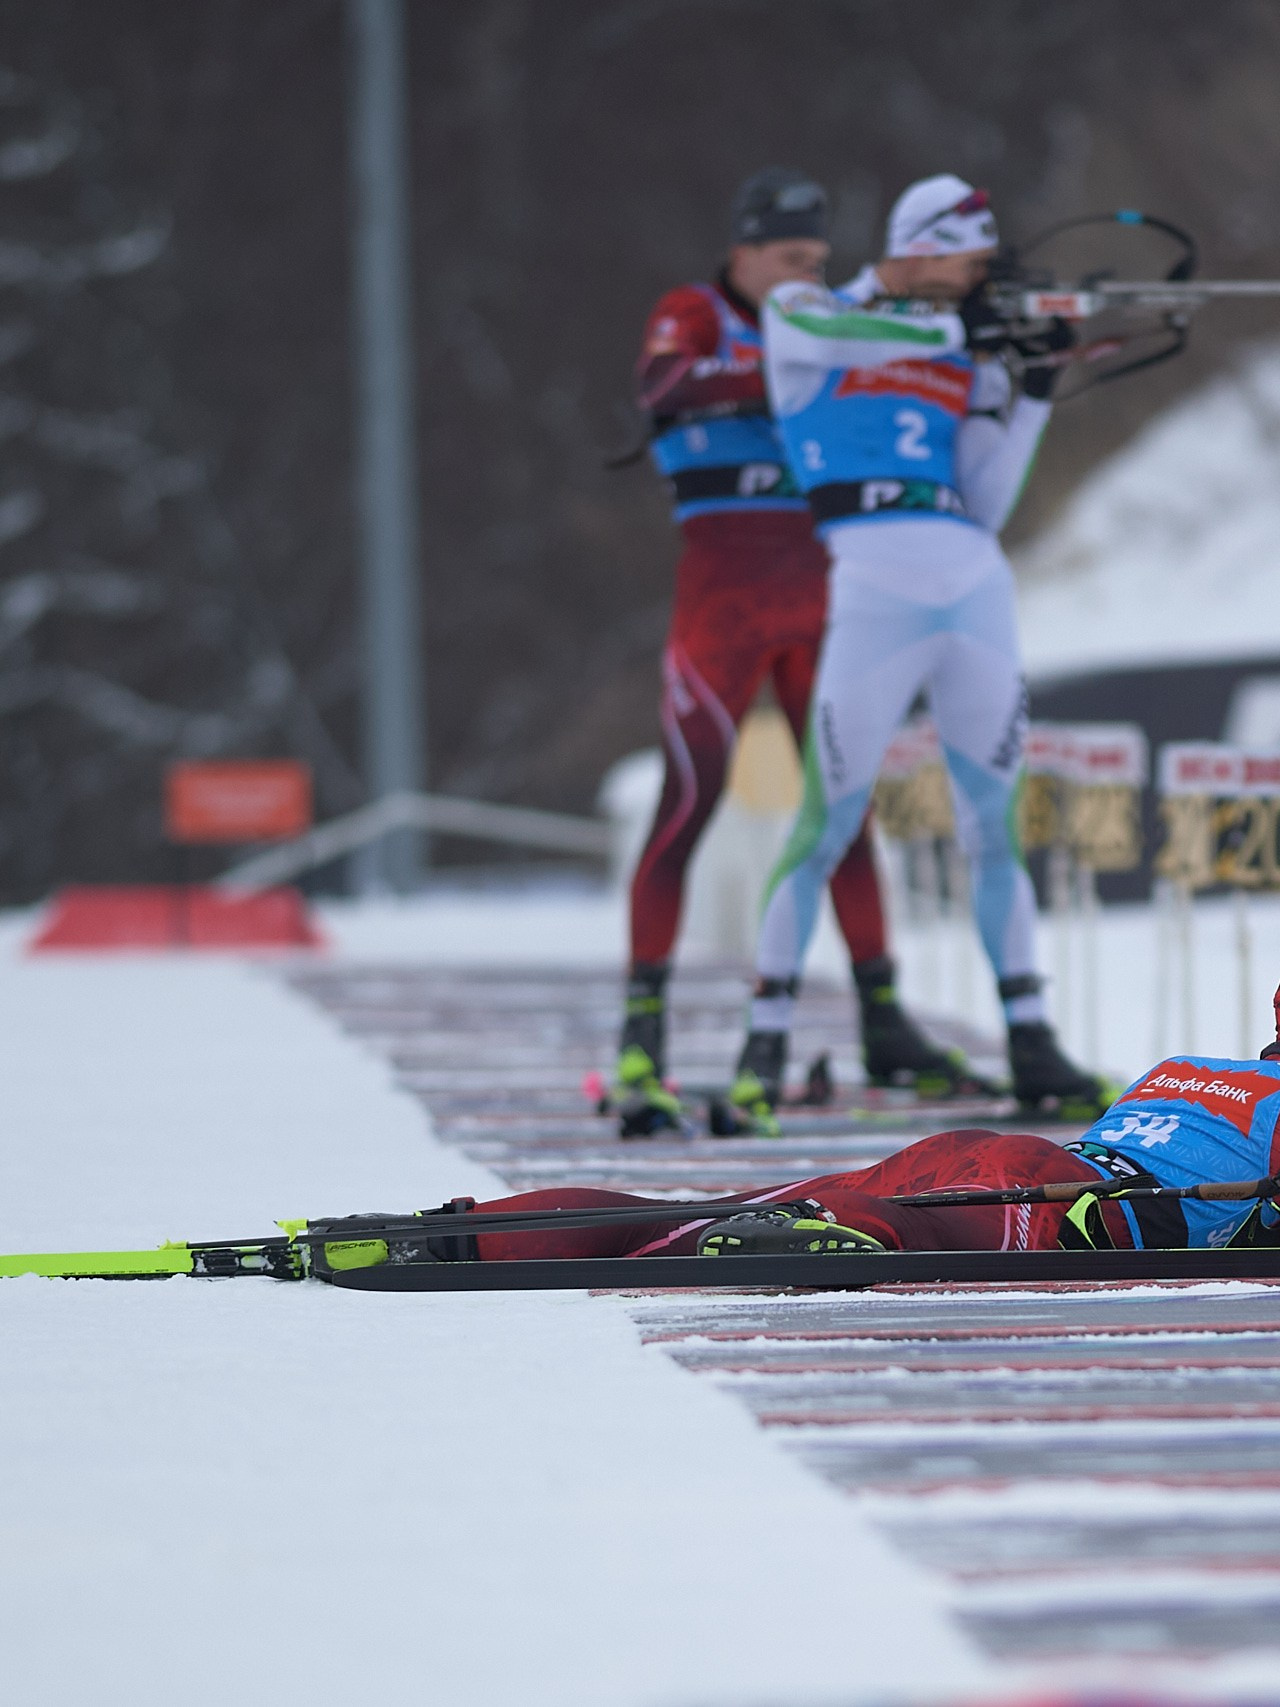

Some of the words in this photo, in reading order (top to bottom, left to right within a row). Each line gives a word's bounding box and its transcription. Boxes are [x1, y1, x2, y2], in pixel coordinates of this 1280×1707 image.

[894, 408, 931, 460] 2
[1141, 1073, 1206, 1093] Альфа
[1203, 1080, 1253, 1104] Банк
